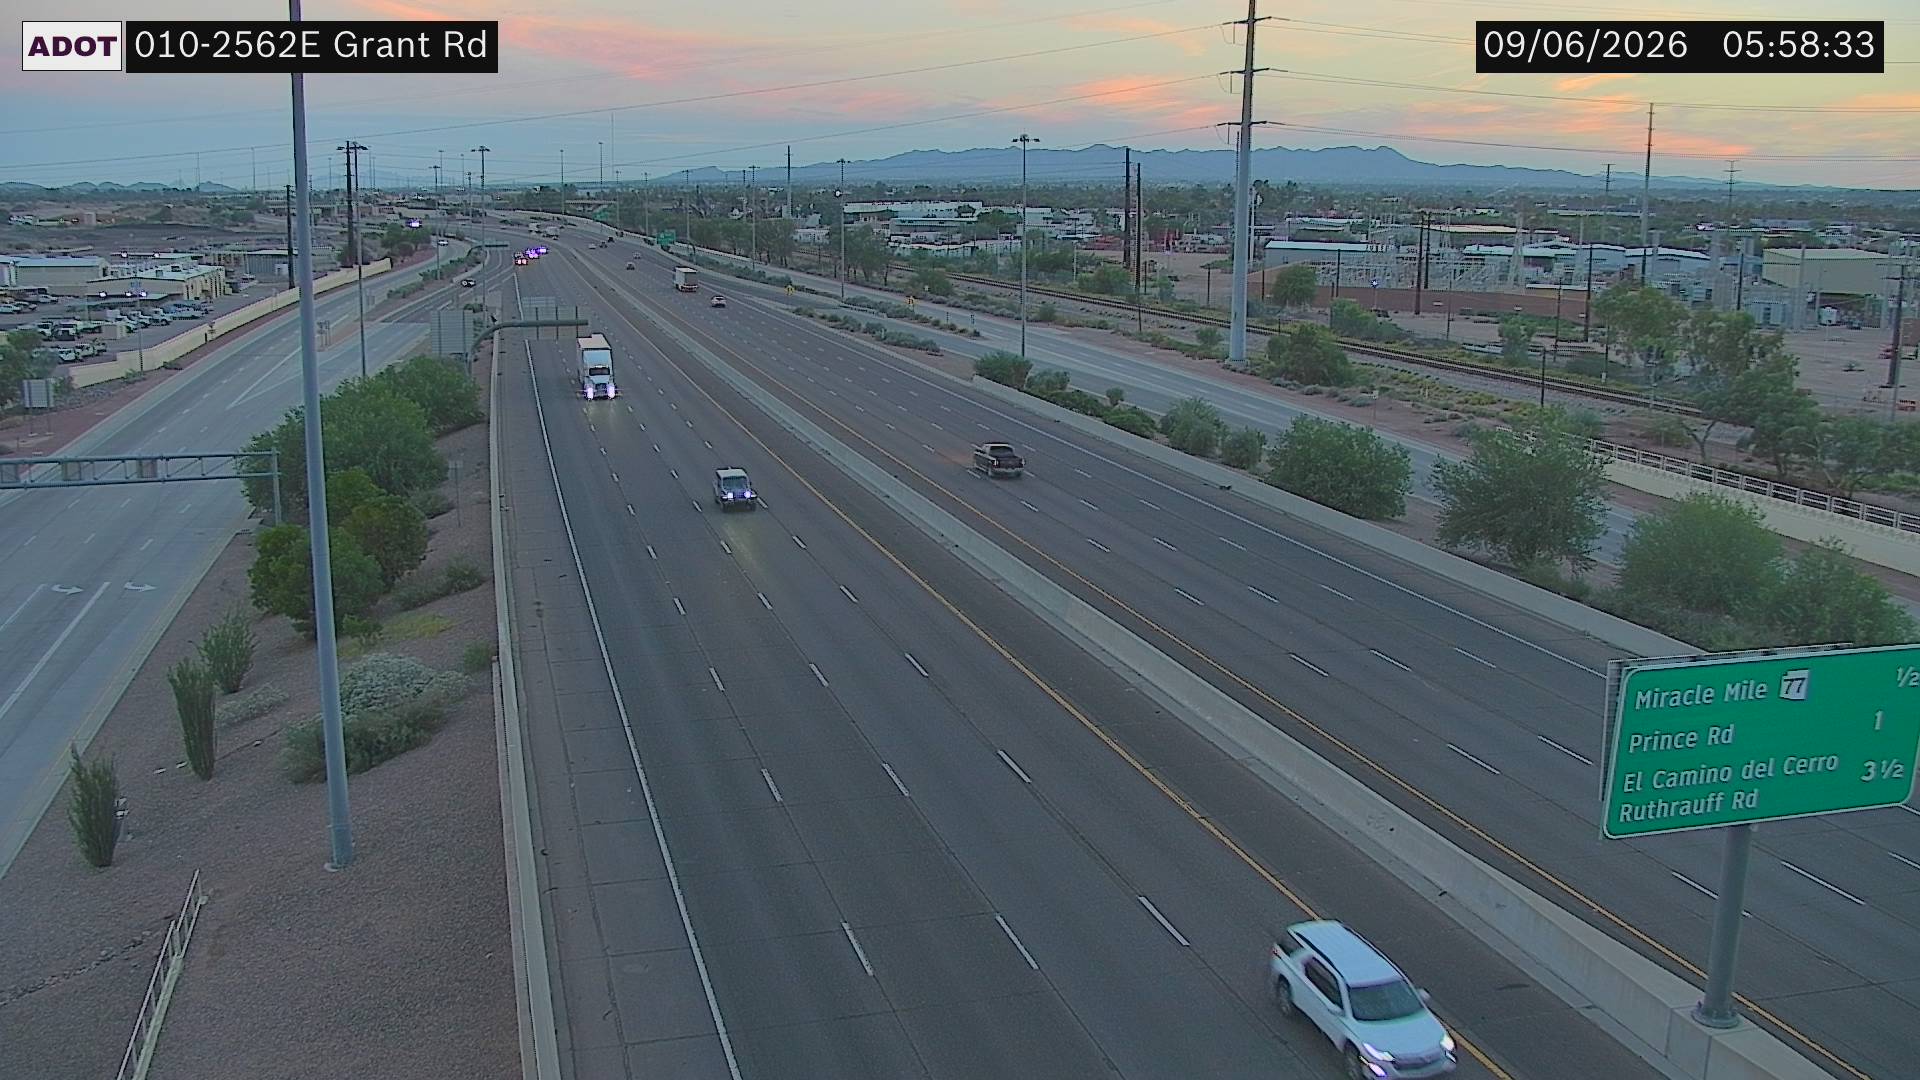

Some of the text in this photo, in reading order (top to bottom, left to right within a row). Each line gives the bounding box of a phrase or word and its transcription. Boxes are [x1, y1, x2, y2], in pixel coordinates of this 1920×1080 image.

[1635, 678, 1806, 710] Miracle Mile 77
[1874, 711, 1884, 730] 1
[1629, 724, 1735, 753] Prince Rd
[1623, 755, 1839, 792] El Camino del Cerro
[1619, 789, 1759, 822] Ruthrauff Rd
